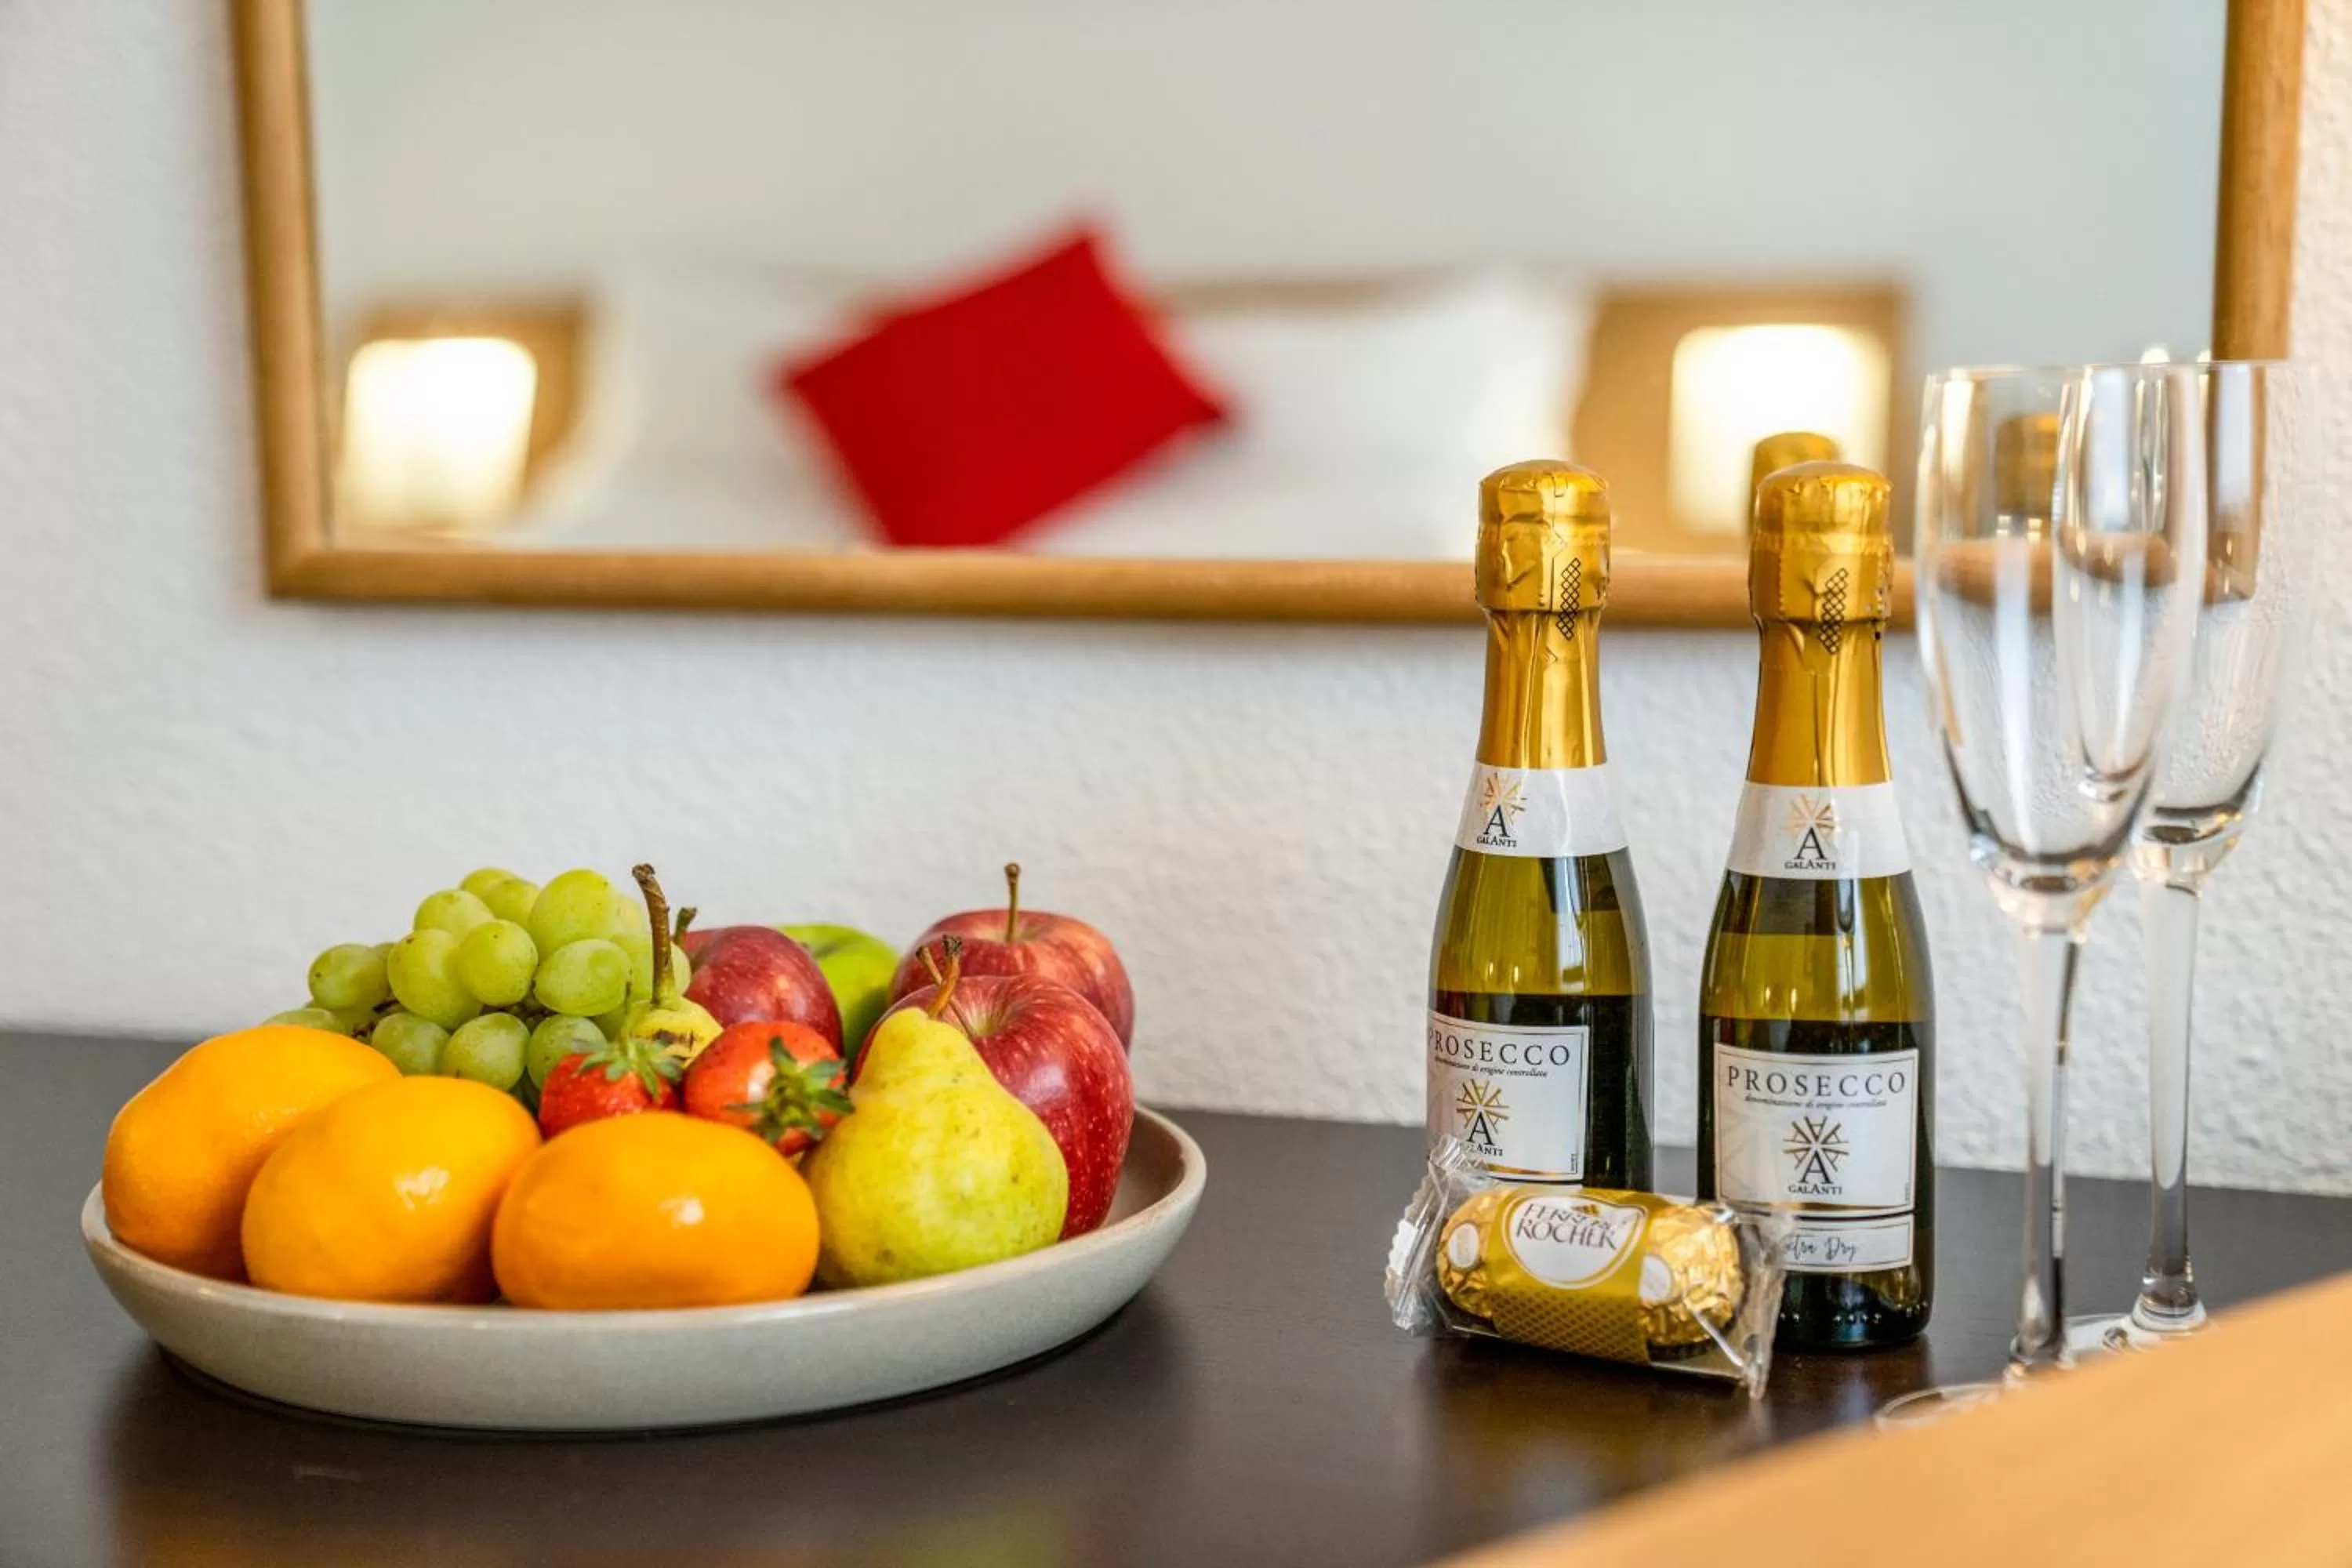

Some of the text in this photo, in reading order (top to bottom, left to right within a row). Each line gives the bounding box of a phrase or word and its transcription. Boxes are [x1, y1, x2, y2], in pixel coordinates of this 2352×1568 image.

[1483, 804, 1510, 837] A
[1476, 835, 1517, 848] GALANTI
[1794, 826, 1828, 860] A
[1784, 859, 1836, 870] GALANTI
[1728, 1065, 1905, 1097] PROSECCO
[1466, 1112, 1495, 1146] A
[1798, 1150, 1833, 1185] A
[1788, 1183, 1842, 1195] GALANTI
[1516, 1218, 1616, 1250] ROCHER
